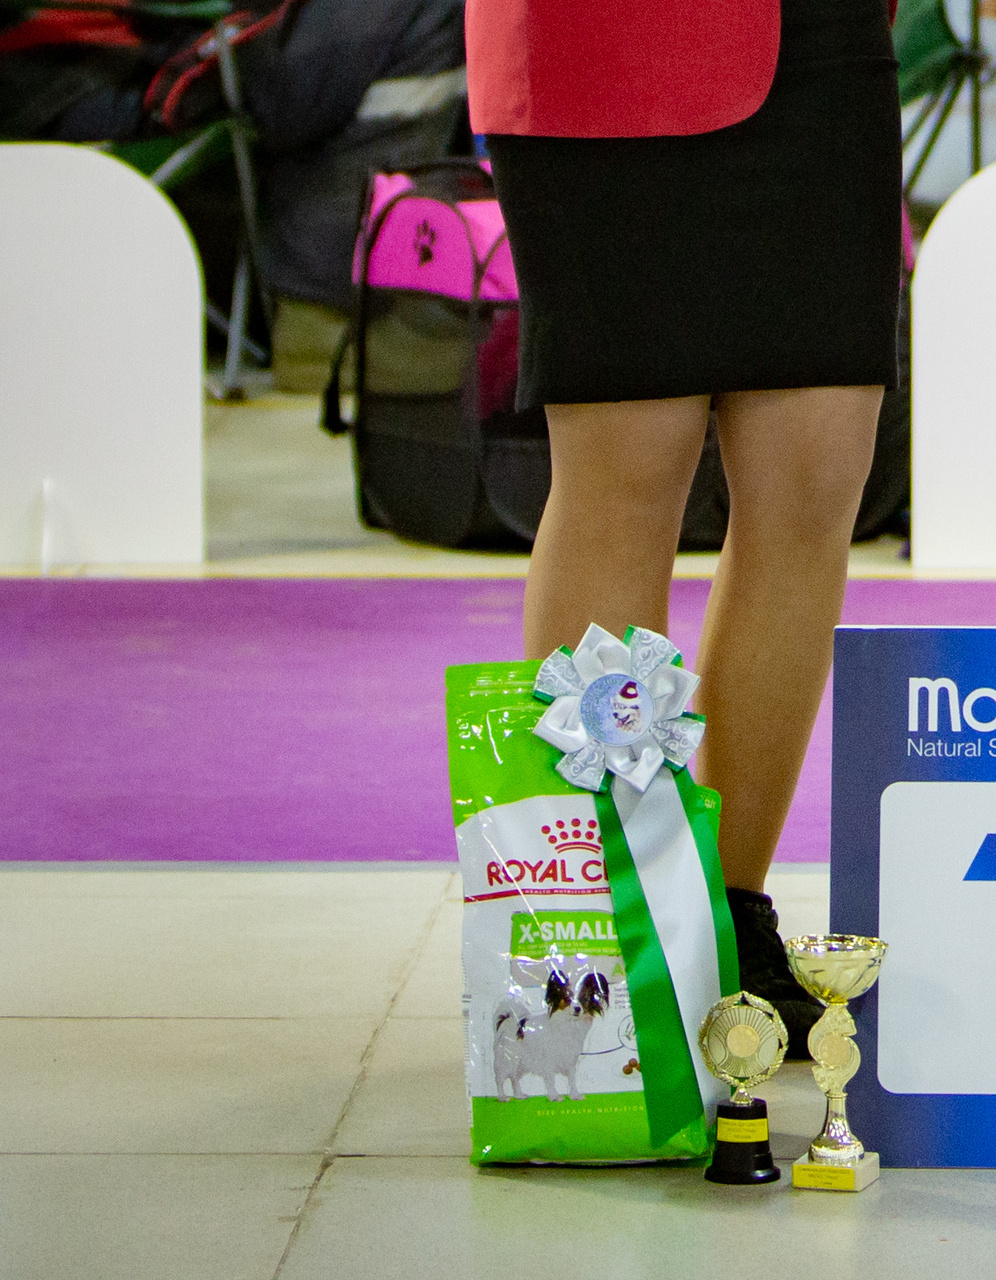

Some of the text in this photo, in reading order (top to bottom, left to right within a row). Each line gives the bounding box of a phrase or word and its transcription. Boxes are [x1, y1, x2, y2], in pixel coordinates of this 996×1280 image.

[906, 738, 982, 758] Natural
[487, 859, 574, 886] ROYAL
[519, 921, 618, 943] X-SMALL
